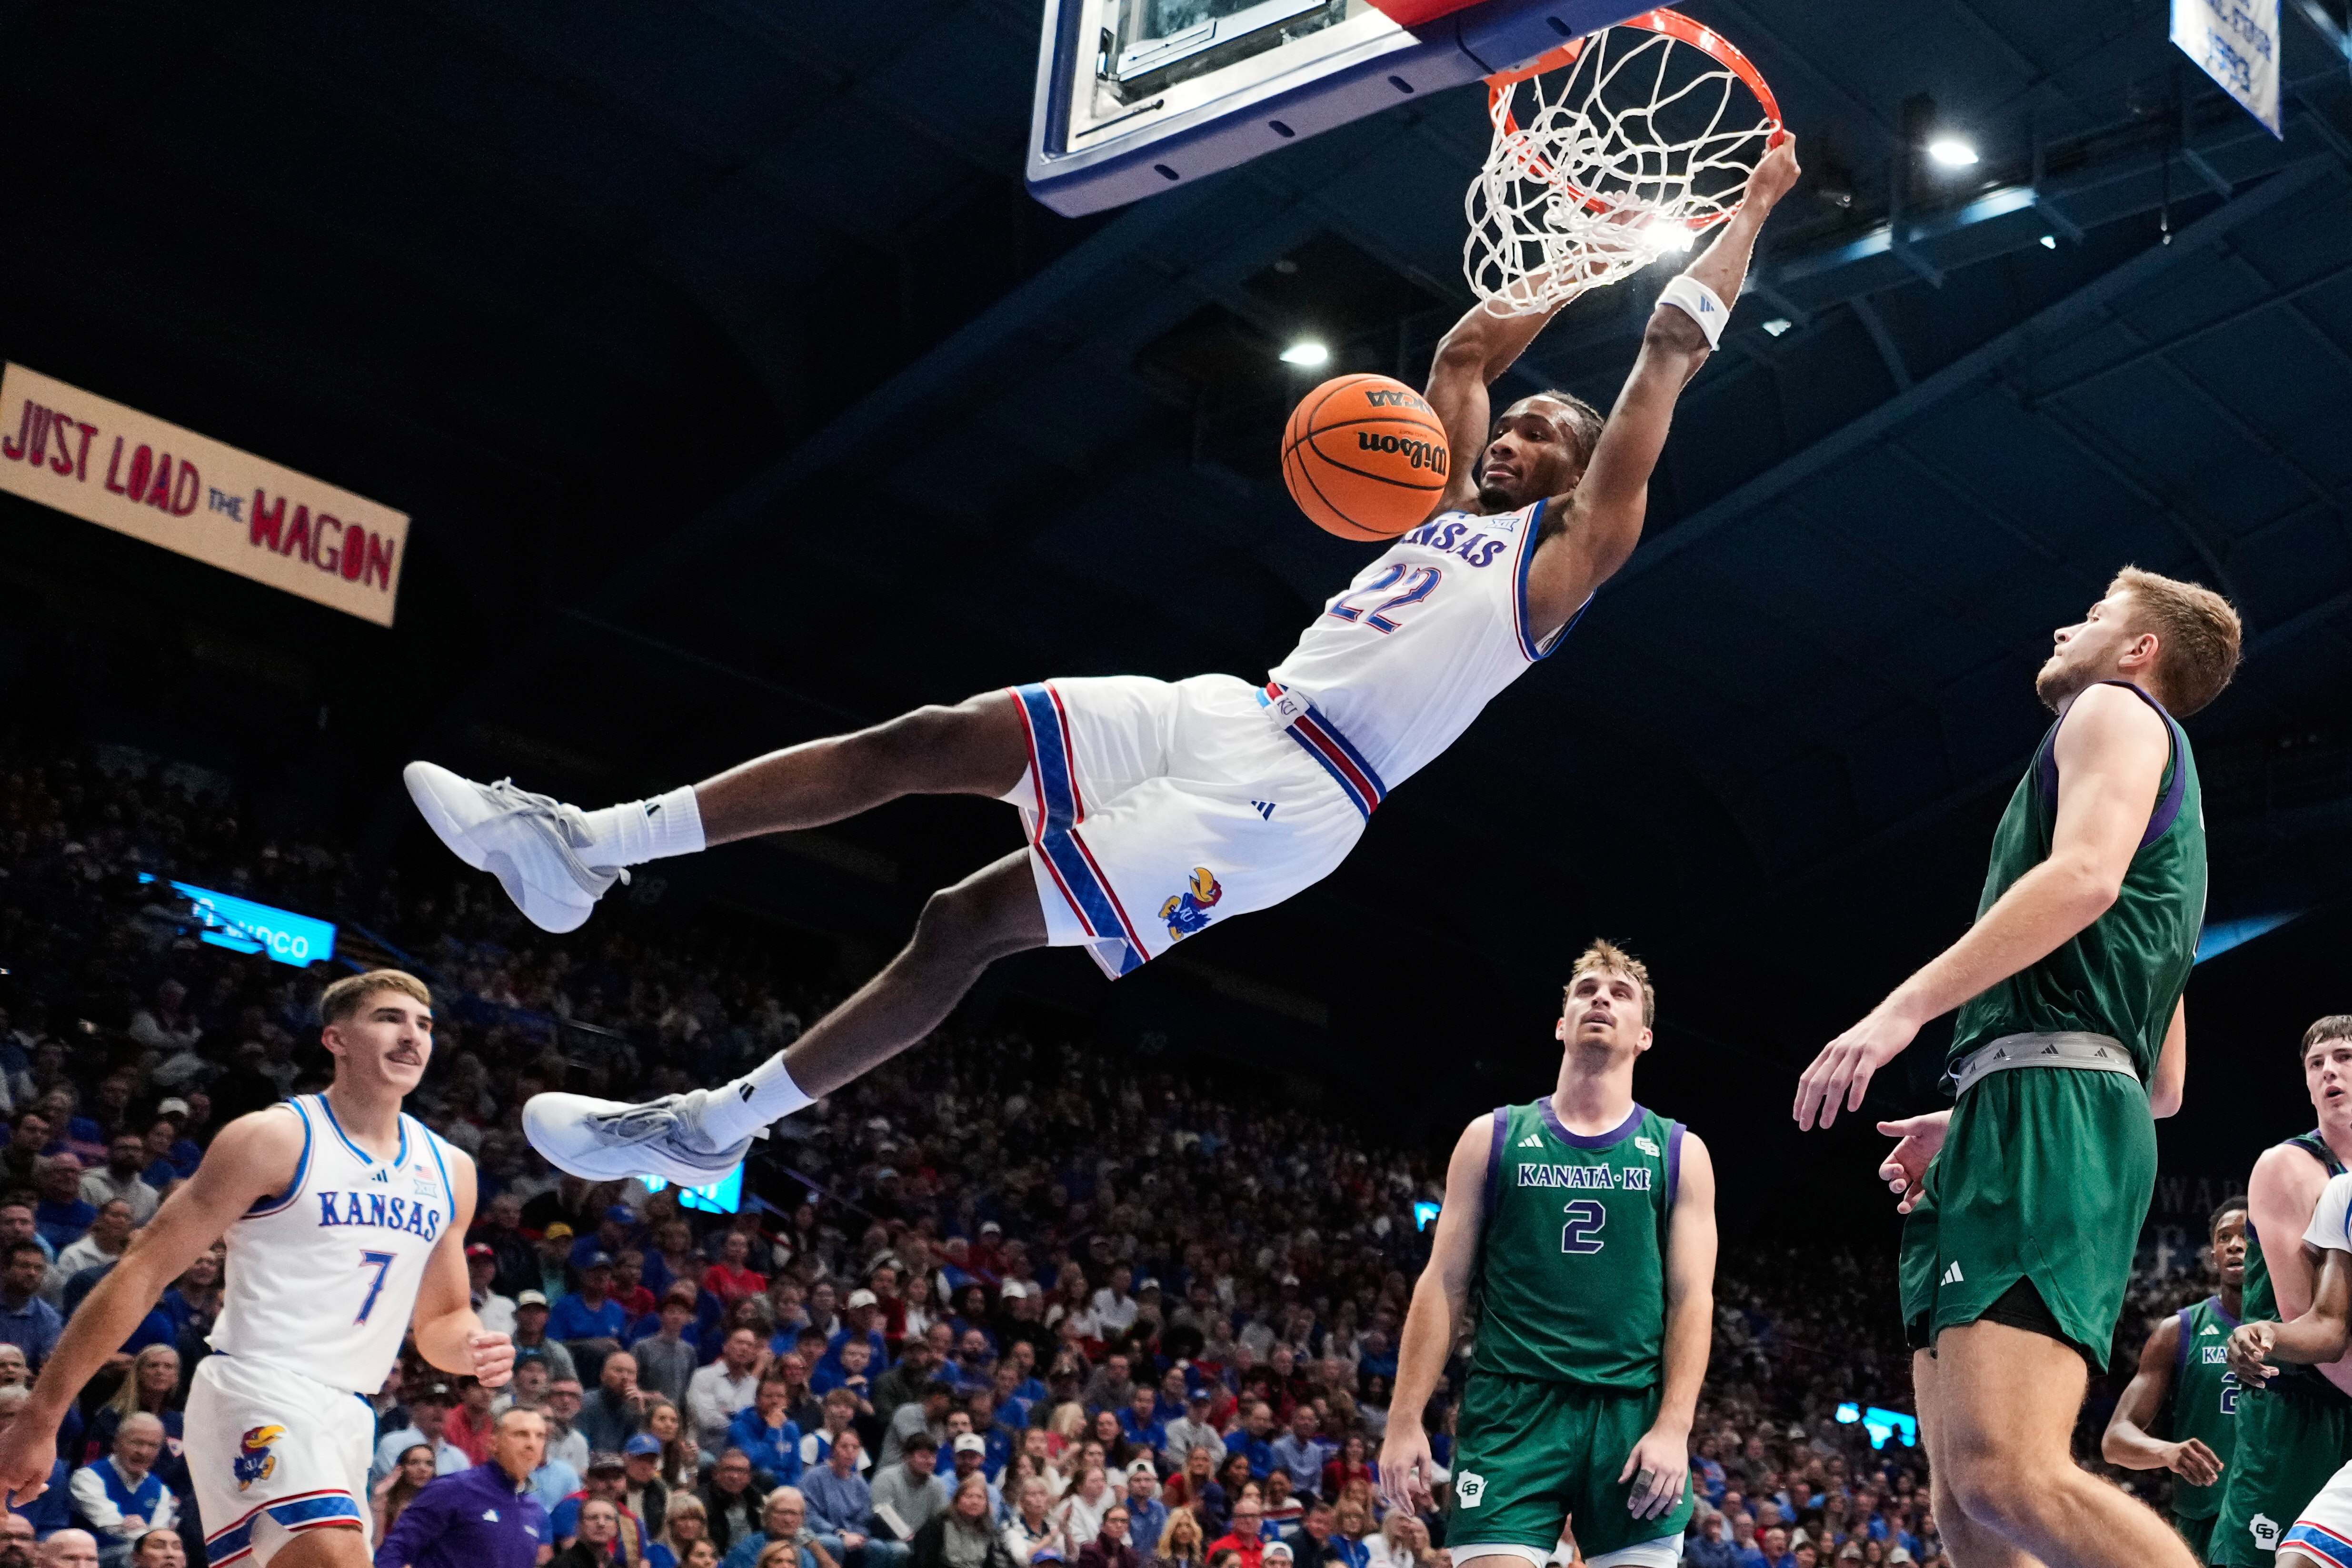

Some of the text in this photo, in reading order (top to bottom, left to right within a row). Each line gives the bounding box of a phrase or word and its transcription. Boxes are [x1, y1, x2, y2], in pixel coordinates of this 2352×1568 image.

[1365, 390, 1434, 417] NCAA
[1358, 431, 1446, 477] Wilson
[2, 400, 395, 591] JUST LOAD THE WAGON
[1399, 519, 1507, 568] NSAS
[1327, 564, 1442, 634] 22
[1277, 698, 1298, 715] KU
[317, 1191, 440, 1242] KANSAS
[1562, 1199, 1606, 1254] 2
[353, 1249, 399, 1327] 7
[2256, 1523, 2274, 1539] GB
